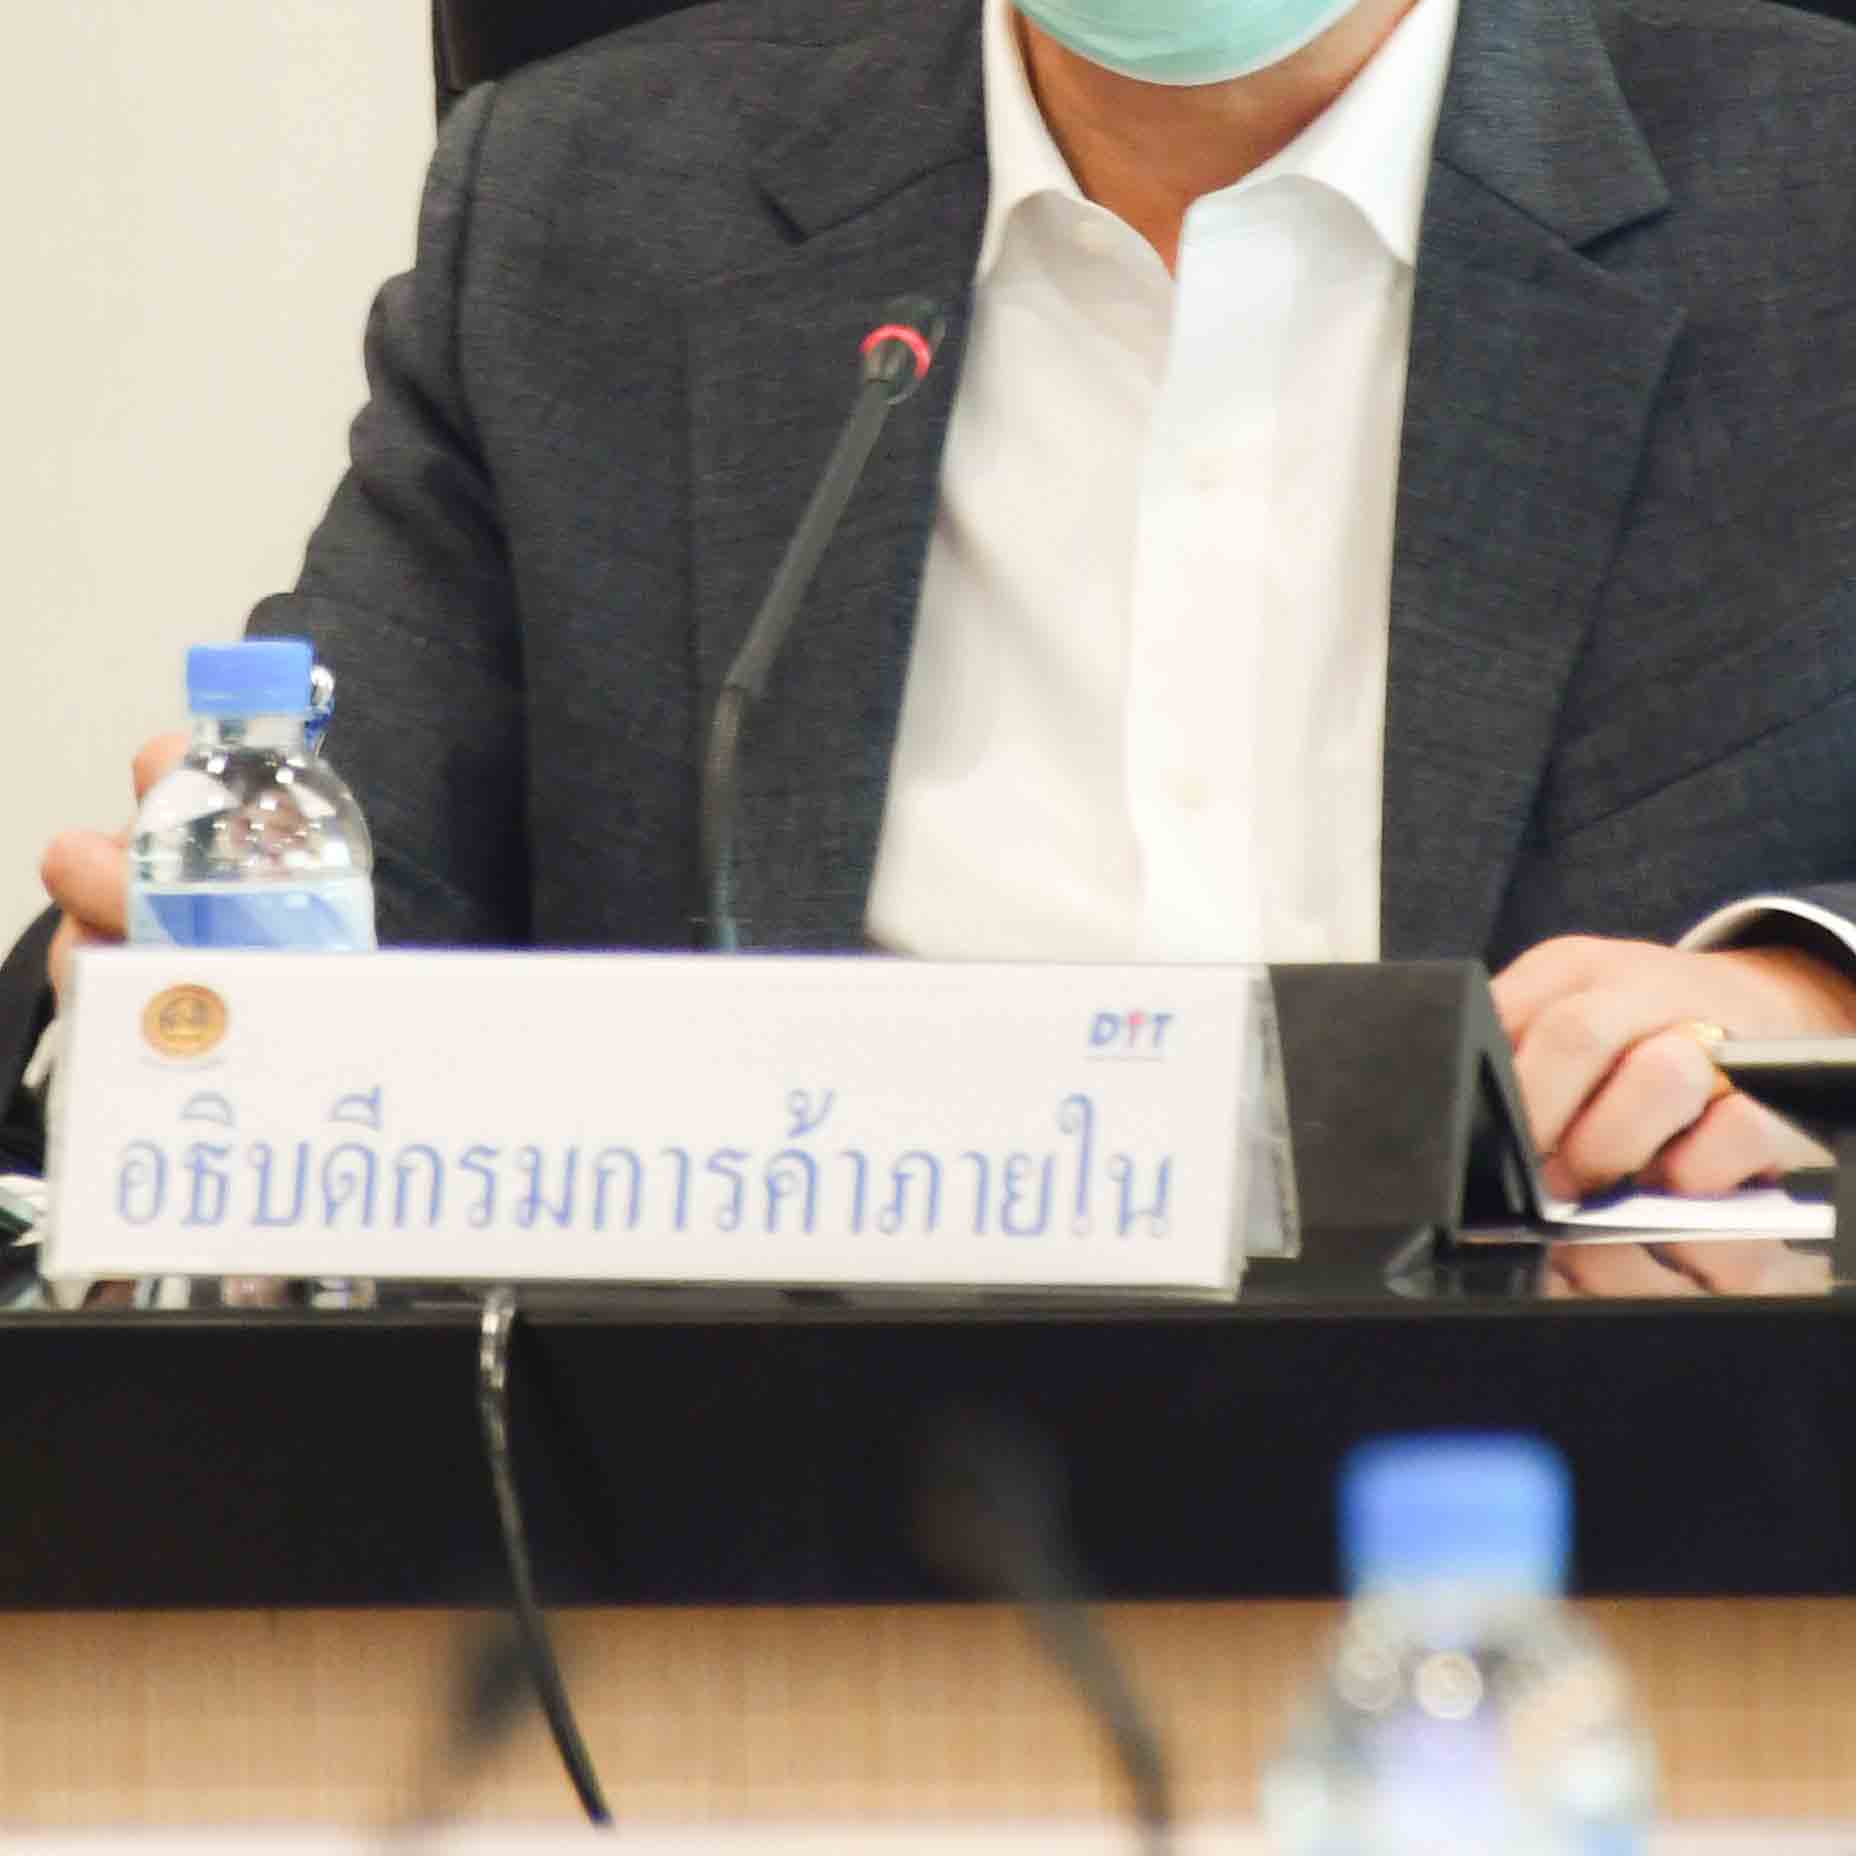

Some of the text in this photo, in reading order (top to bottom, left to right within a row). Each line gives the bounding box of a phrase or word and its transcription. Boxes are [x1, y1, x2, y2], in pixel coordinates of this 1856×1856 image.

[114, 1085, 1174, 1237] อธิบดีกรมการค้าภายใน
